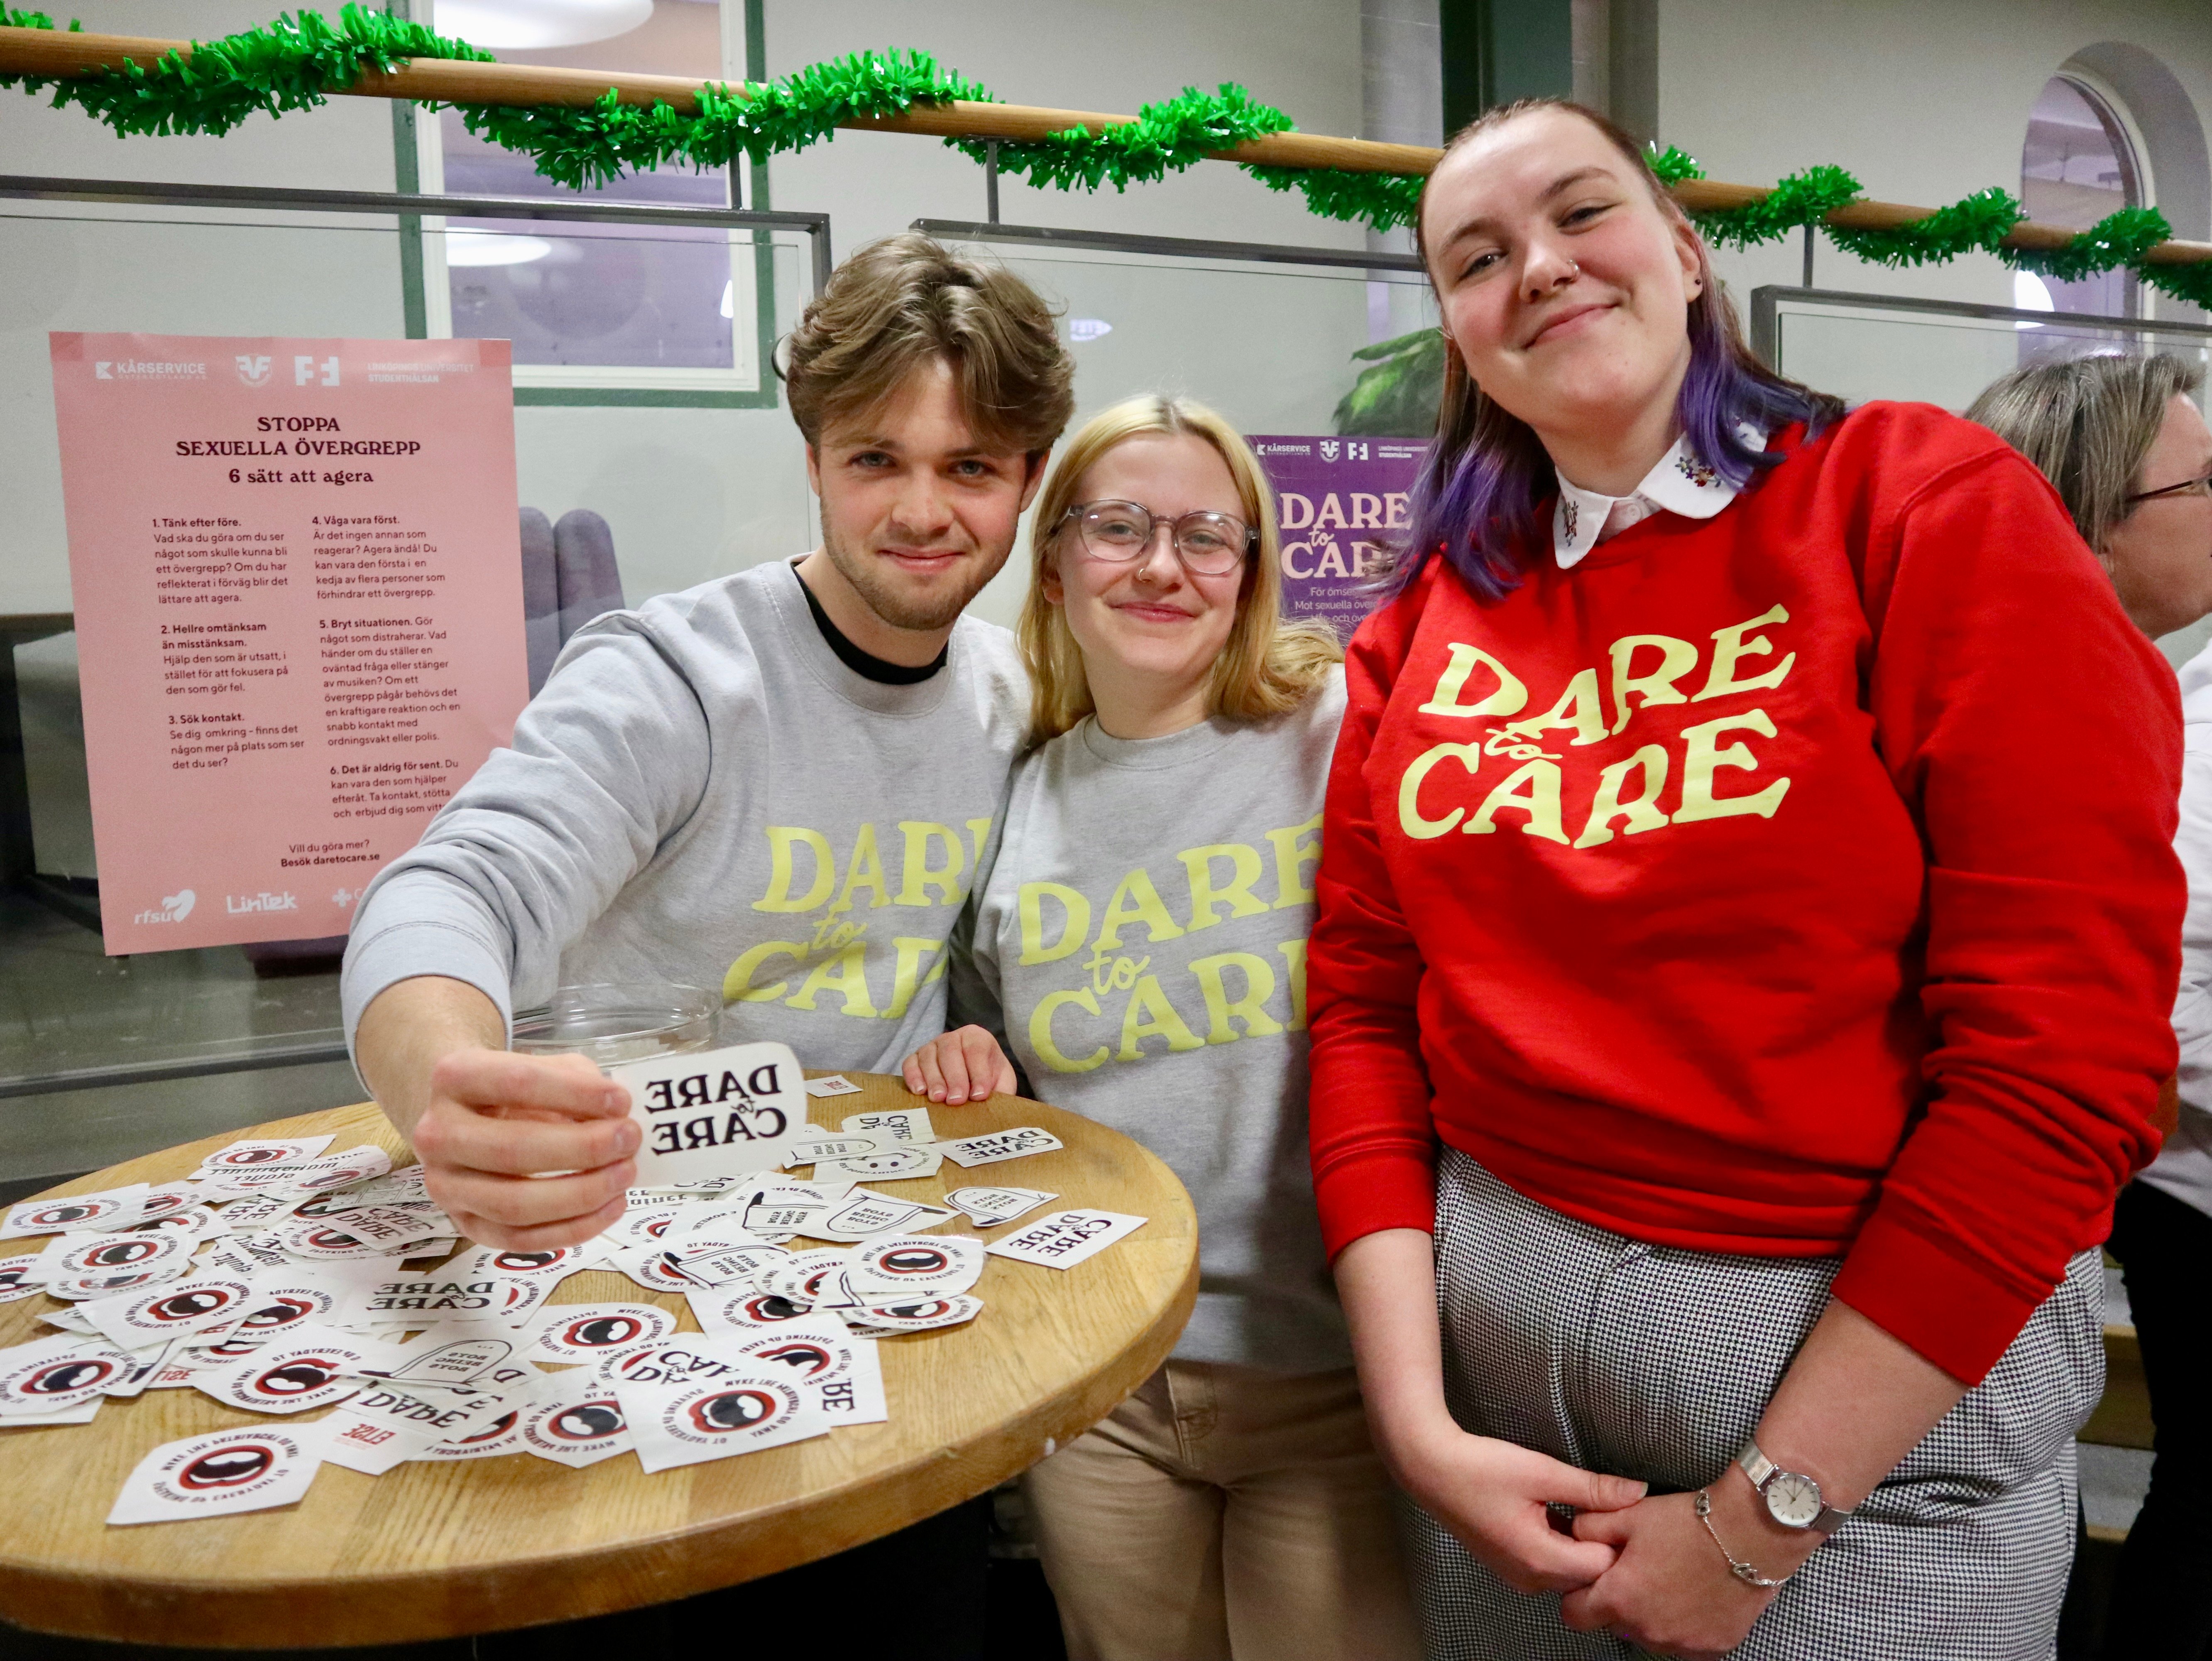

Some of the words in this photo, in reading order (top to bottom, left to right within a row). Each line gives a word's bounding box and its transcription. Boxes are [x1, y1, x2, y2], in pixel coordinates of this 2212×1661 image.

[117, 359, 206, 374] KÅRSERVICE
[257, 416, 340, 431] STOPPA
[176, 441, 288, 456] SEXUELLA
[295, 436, 421, 456] ÖVERGREPP
[1267, 443, 1311, 453] KÅRSERVICE
[229, 468, 240, 483] 6
[247, 468, 283, 483] sätt
[290, 470, 316, 483] att
[323, 470, 374, 486] agera
[1280, 492, 1413, 530] DARE
[152, 518, 160, 528] 1.
[162, 518, 187, 528] Tänk
[190, 517, 215, 527] efter
[217, 517, 241, 527] före.
[312, 516, 321, 525] 4.
[323, 515, 349, 527] Våga
[374, 515, 399, 524] först.
[154, 533, 174, 543] Vad
[176, 534, 193, 543] ska
[195, 533, 209, 543] du
[211, 533, 234, 545] göra
[254, 532, 267, 541] du
[313, 528, 325, 540] Är
[327, 531, 343, 540] det
[345, 531, 373, 542] ingen
[1308, 527, 1335, 546] to
[154, 549, 184, 561] något
[210, 548, 240, 557] skulle
[242, 547, 273, 556] kunna
[275, 546, 287, 556] bli
[314, 544, 361, 557] reagerar?
[363, 544, 392, 556] Agera
[394, 543, 420, 554] ändå!
[423, 543, 437, 553] Du
[156, 565, 171, 574] ett
[173, 562, 232, 575] övergrepp?
[234, 562, 253, 572] Om
[255, 562, 268, 571] du
[271, 561, 287, 571] har
[315, 560, 333, 570] kan
[357, 560, 376, 569] den
[378, 559, 406, 568] första
[157, 579, 211, 589] reflekterat
[218, 578, 251, 589] förväg
[253, 577, 269, 587] blir
[271, 576, 288, 586] det
[316, 575, 343, 587] kedja
[357, 574, 380, 583] flera
[382, 575, 424, 585] personer
[159, 594, 192, 604] lättare
[194, 594, 208, 603] att
[211, 595, 242, 605] agera.
[317, 589, 365, 599] förhindrar
[367, 589, 382, 598] ett
[384, 589, 435, 599] övergrepp.
[1295, 600, 1313, 610] Mot
[1315, 600, 1352, 610] sexuella
[319, 619, 328, 629] 5.
[331, 619, 352, 630] Bryt
[354, 618, 412, 628] situationen.
[415, 616, 433, 625] Gör
[1332, 614, 1349, 622] och
[161, 625, 170, 635] 2.
[173, 624, 204, 634] Hellre
[206, 622, 267, 632] omtänksam
[162, 640, 175, 649] än
[177, 639, 247, 649] misstänksam.
[1418, 603, 1796, 746] DARE
[169, 715, 178, 725] 3.
[180, 714, 200, 724] Sök
[201, 713, 244, 723] kontakt.
[1485, 728, 1564, 761] to
[330, 766, 339, 775] 6.
[342, 765, 360, 774] Det
[362, 764, 371, 773] är
[374, 762, 401, 774] aldrig
[403, 761, 417, 771] för
[419, 761, 442, 770] sent.
[445, 759, 458, 768] Du
[1398, 708, 1791, 850] CARE
[289, 844, 305, 854] Vill
[307, 843, 320, 853] du
[322, 843, 343, 852] göra
[345, 839, 369, 849] mer?
[281, 857, 311, 867] Besök
[313, 854, 380, 865] daretocare.se
[226, 890, 298, 914] LinTek
[133, 909, 174, 924] rfsu
[808, 911, 867, 950] to
[1083, 955, 1151, 996] to
